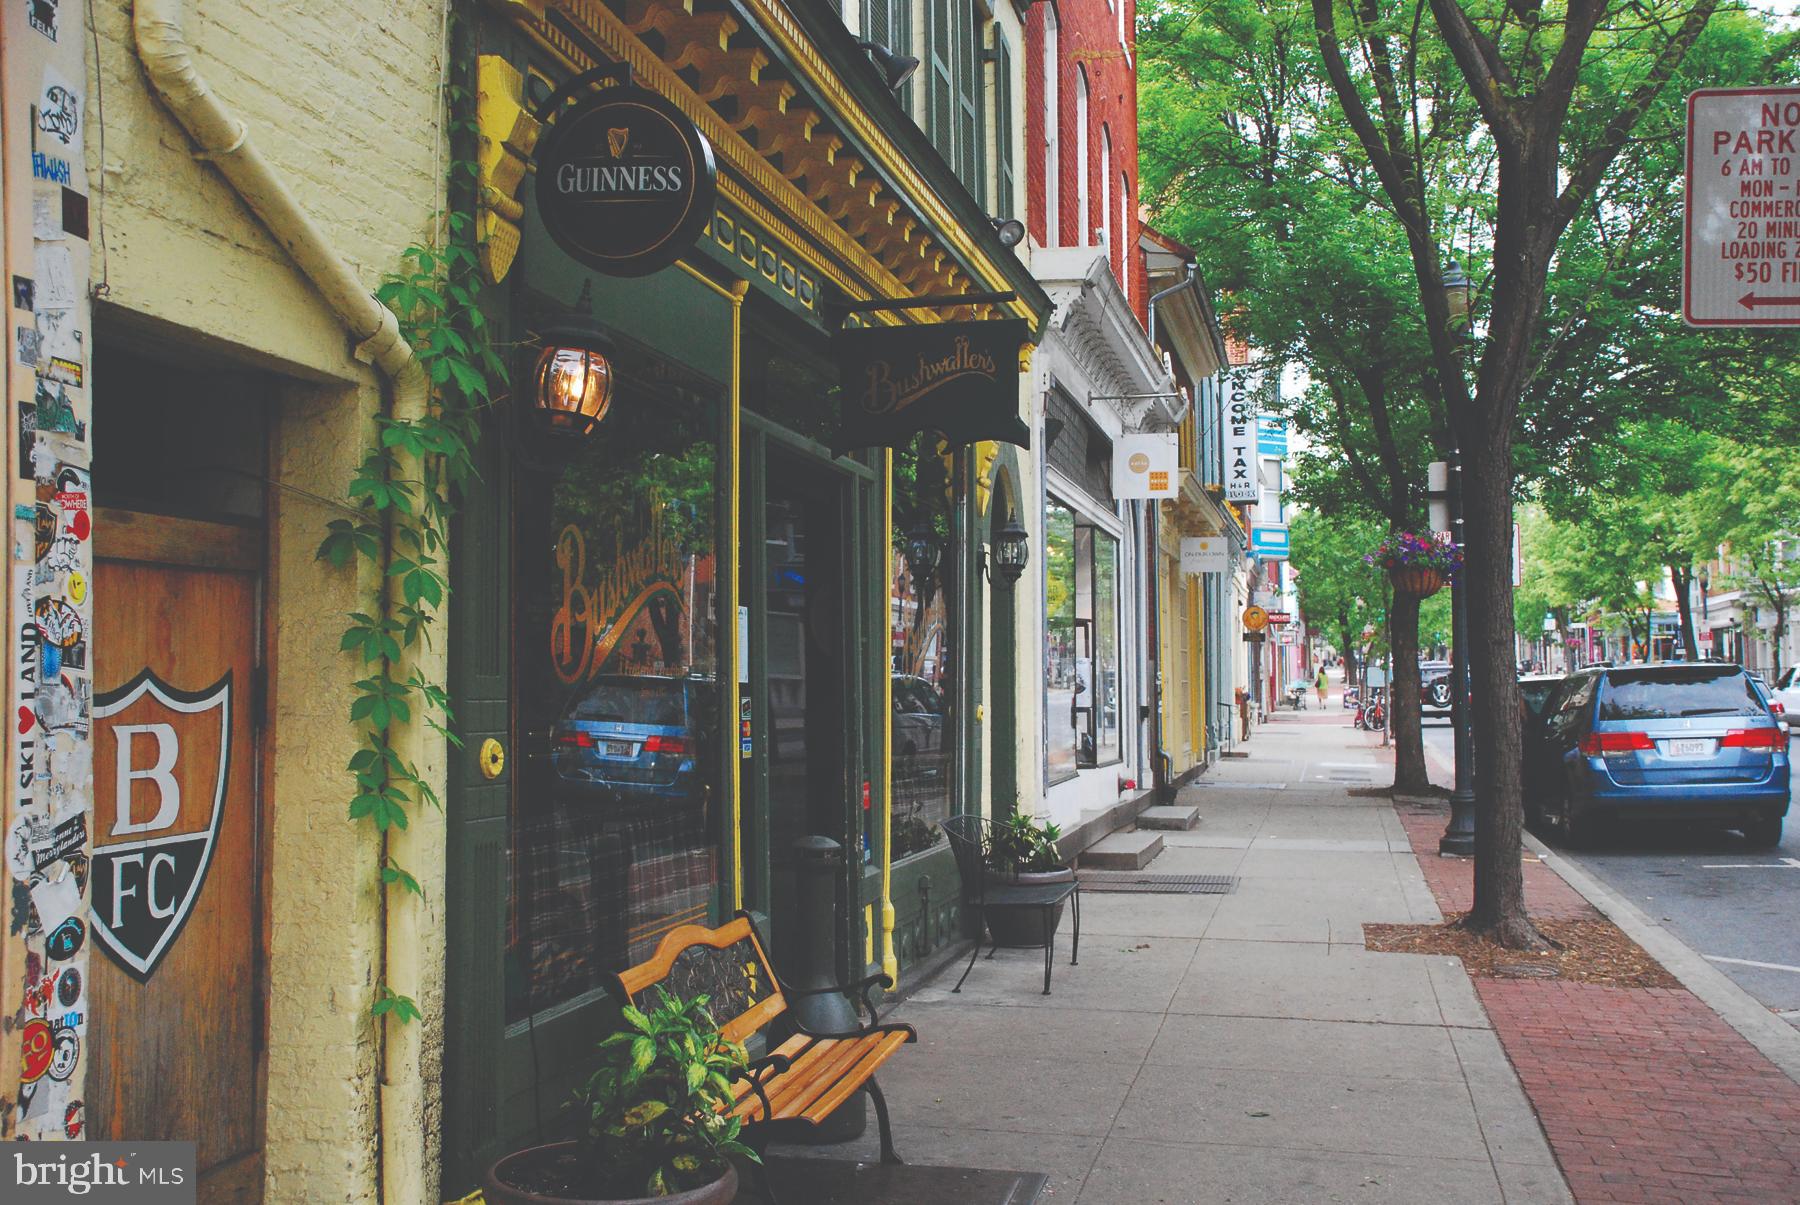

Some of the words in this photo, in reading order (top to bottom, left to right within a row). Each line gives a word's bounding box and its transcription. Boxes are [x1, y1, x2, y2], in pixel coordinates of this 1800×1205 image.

[1761, 101, 1800, 128] NO
[1713, 130, 1795, 156] PARK
[556, 163, 682, 194] GUINNESS
[1721, 159, 1731, 177] 6
[1739, 158, 1763, 176] AM
[1771, 158, 1790, 176] TO
[1740, 179, 1774, 198] MON
[1737, 220, 1758, 239] 20
[1721, 241, 1787, 260] LOADING
[1734, 262, 1771, 284] $50
[861, 335, 997, 415] Bushwaller's
[1232, 446, 1248, 479] TAX
[20, 740, 35, 788] SKI
[111, 722, 180, 836] B
[111, 852, 176, 929] FC
